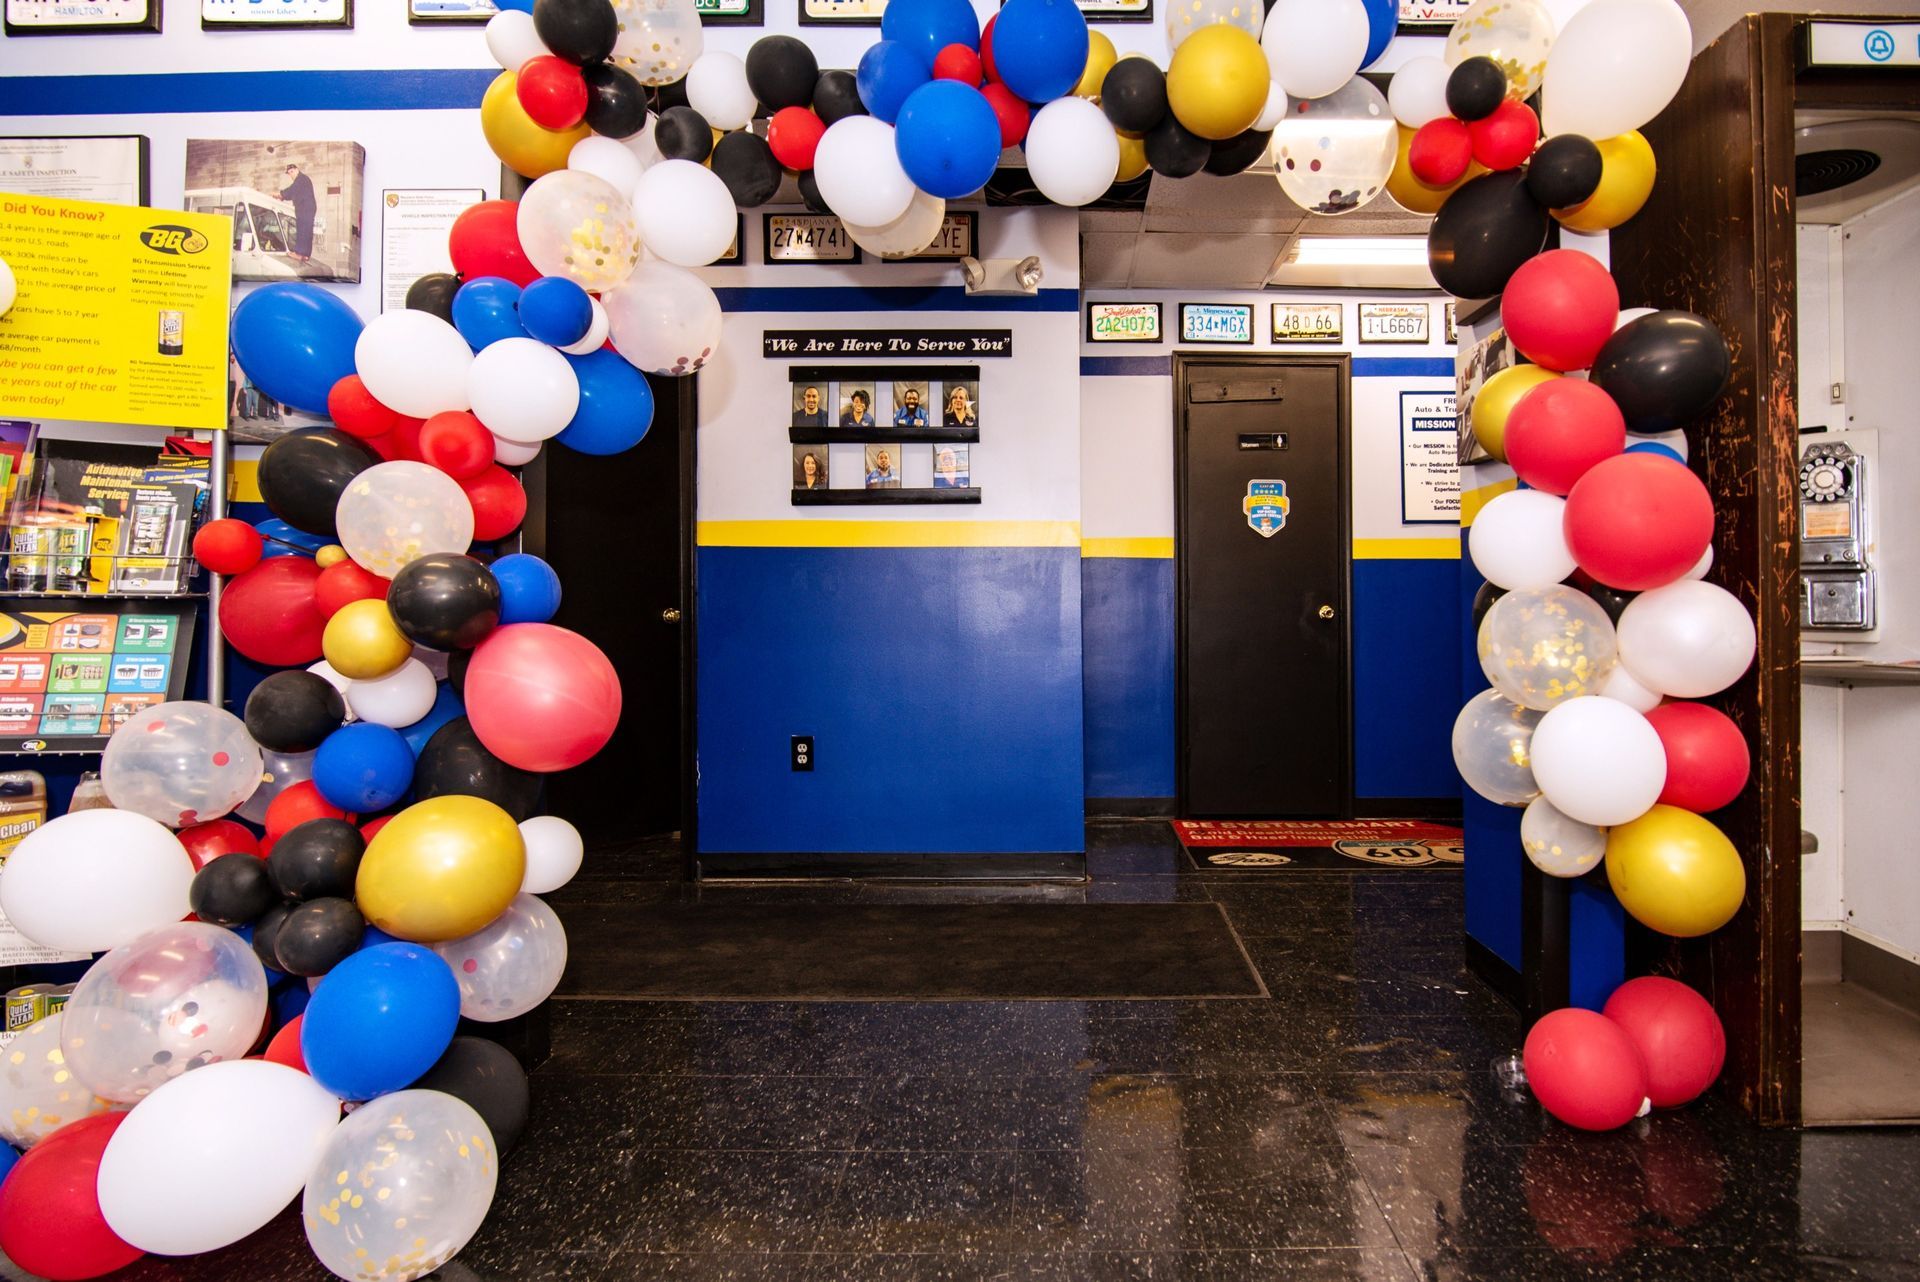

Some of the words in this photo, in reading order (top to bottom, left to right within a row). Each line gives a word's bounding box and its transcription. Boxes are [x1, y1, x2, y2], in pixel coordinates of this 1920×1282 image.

[54, 7, 104, 16] HAMILTON
[4, 202, 27, 214] Did
[32, 205, 55, 217] You
[60, 208, 105, 222] Know?
[38, 225, 44, 233] is
[46, 227, 60, 235] the
[62, 230, 94, 239] average
[96, 233, 110, 241] age
[28, 238, 42, 246] U.S.
[46, 240, 70, 248] roads
[38, 253, 60, 262] miles
[78, 256, 89, 264] be
[144, 258, 187, 269] Transmission
[187, 263, 212, 271] Service
[51, 266, 81, 277] today's
[160, 270, 188, 279] Lifetime
[35, 280, 50, 288] the
[51, 283, 83, 292] average
[85, 284, 106, 293] price
[131, 277, 163, 287] Warranty
[176, 281, 193, 290] keep
[193, 283, 209, 291] your
[130, 297, 149, 305] many
[142, 289, 168, 298] running
[169, 290, 195, 299] smooth
[195, 292, 205, 300] for
[63, 309, 73, 317] to
[1202, 307, 1234, 315] Minnesota
[1096, 315, 1156, 333] 2A24073
[7, 332, 40, 341] average
[56, 335, 92, 345] payment
[803, 338, 836, 351] Are
[840, 338, 883, 351] Here
[888, 338, 912, 351] To
[917, 338, 966, 351] Serve
[20, 360, 41, 371] you
[43, 362, 64, 372] can
[66, 364, 85, 374] get
[87, 366, 95, 374] a
[96, 365, 118, 376] few
[11, 377, 41, 387] years
[43, 380, 62, 389] out
[65, 380, 77, 392] of
[79, 381, 98, 391] the
[99, 384, 118, 392] car
[1, 394, 26, 403] own
[29, 395, 66, 407] today!
[1415, 420, 1456, 429] MISSION
[86, 463, 143, 478] Automotive
[14, 532, 38, 545] QUICK
[0, 819, 37, 839] Clean
[1220, 821, 1324, 829] SYSTEM
[1327, 821, 1416, 829] SMART
[1366, 847, 1422, 858] 60
[10, 1002, 34, 1018] QUICK
[10, 1012, 34, 1028] CLEAN
